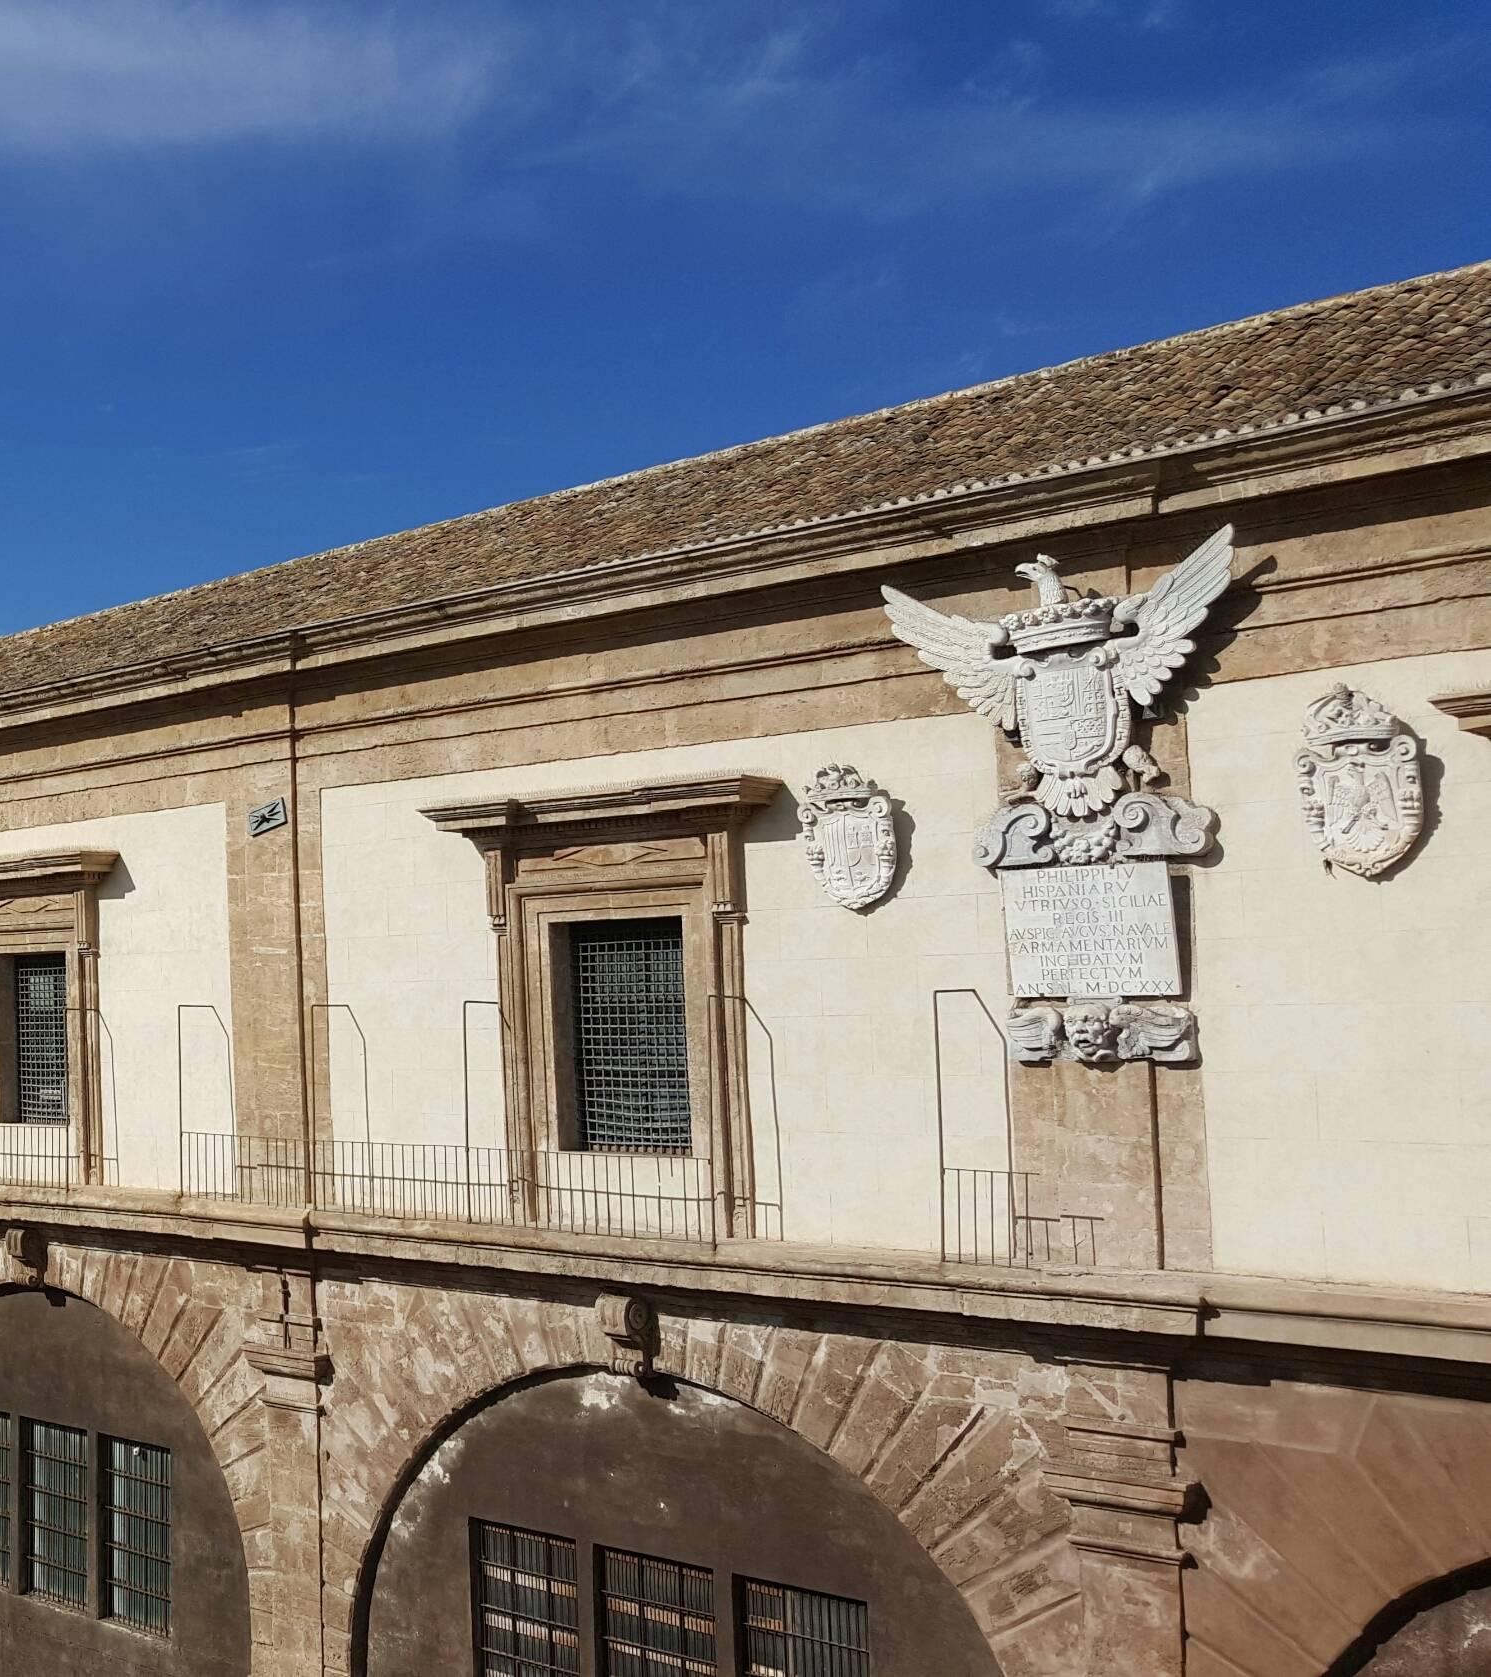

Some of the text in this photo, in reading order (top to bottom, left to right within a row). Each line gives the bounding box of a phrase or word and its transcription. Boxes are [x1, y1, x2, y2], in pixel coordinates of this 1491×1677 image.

[1102, 893, 1169, 909] SICILIAE
[1113, 922, 1174, 938] NAVALE
[1018, 936, 1168, 954] ARMAMENTARIVM
[1042, 966, 1142, 981] PERFECTVM
